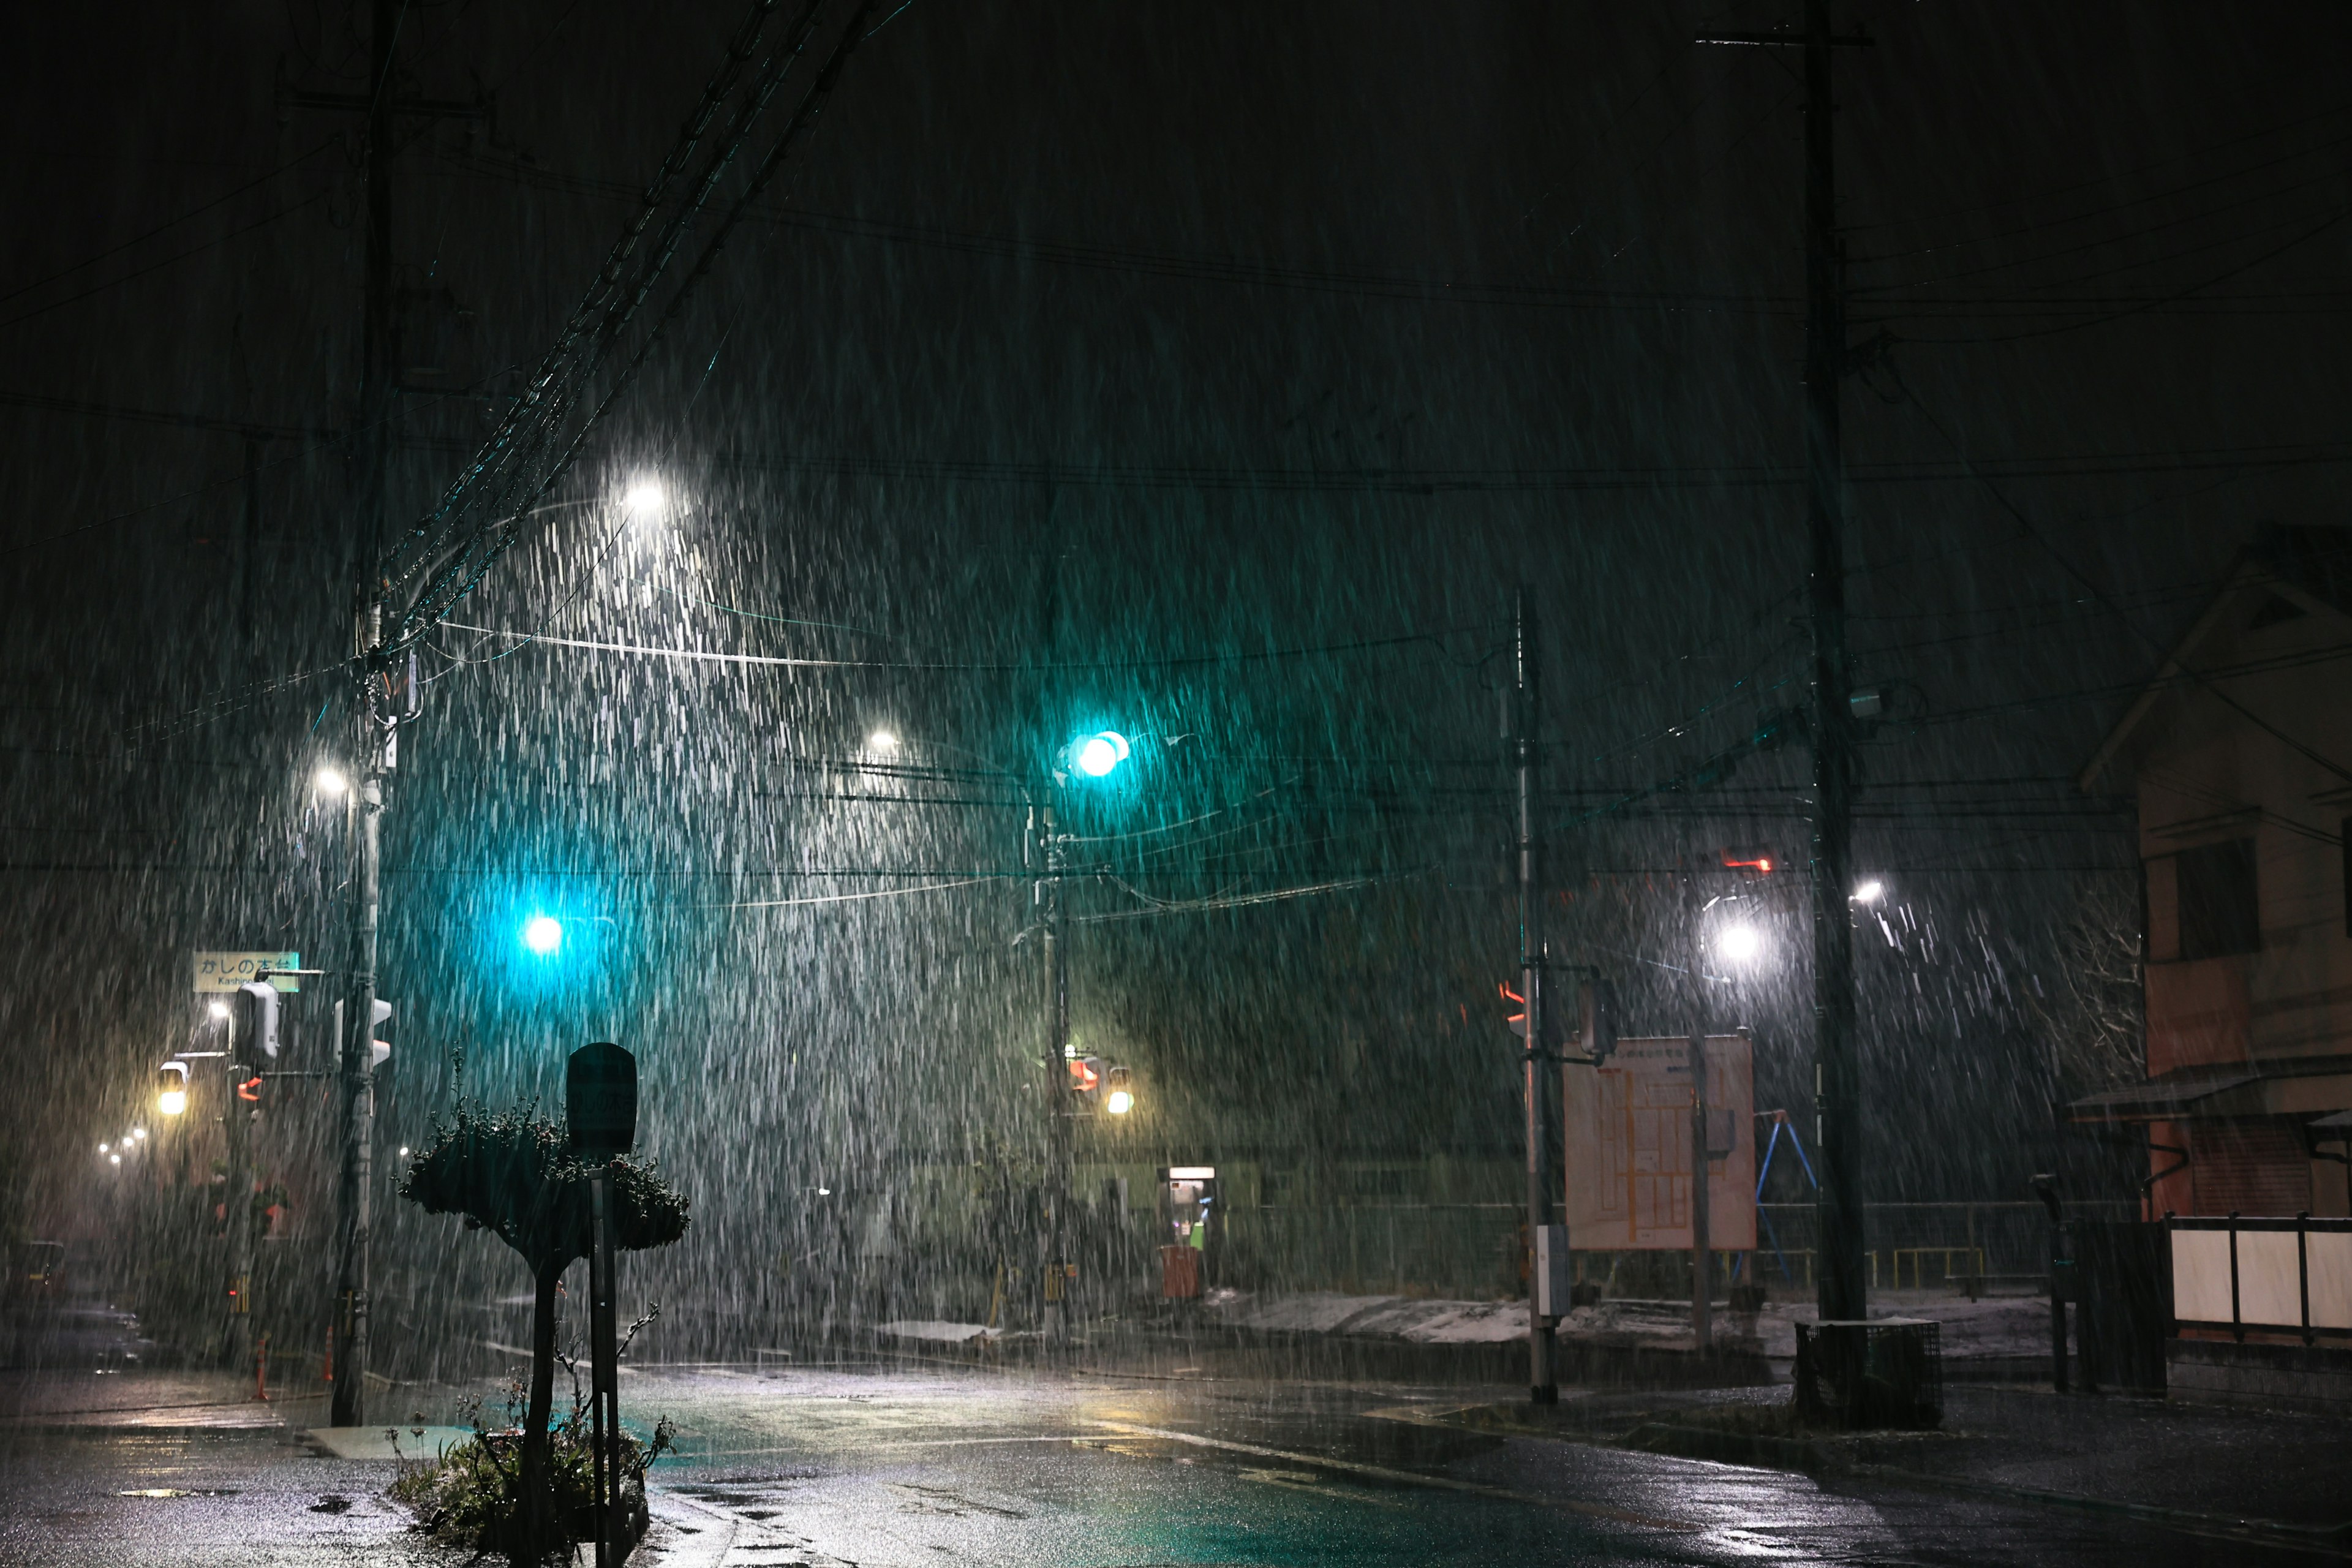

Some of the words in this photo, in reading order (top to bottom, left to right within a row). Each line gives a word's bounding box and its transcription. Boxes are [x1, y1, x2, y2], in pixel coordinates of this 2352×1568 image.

[570, 1088, 635, 1114] かしの木台
